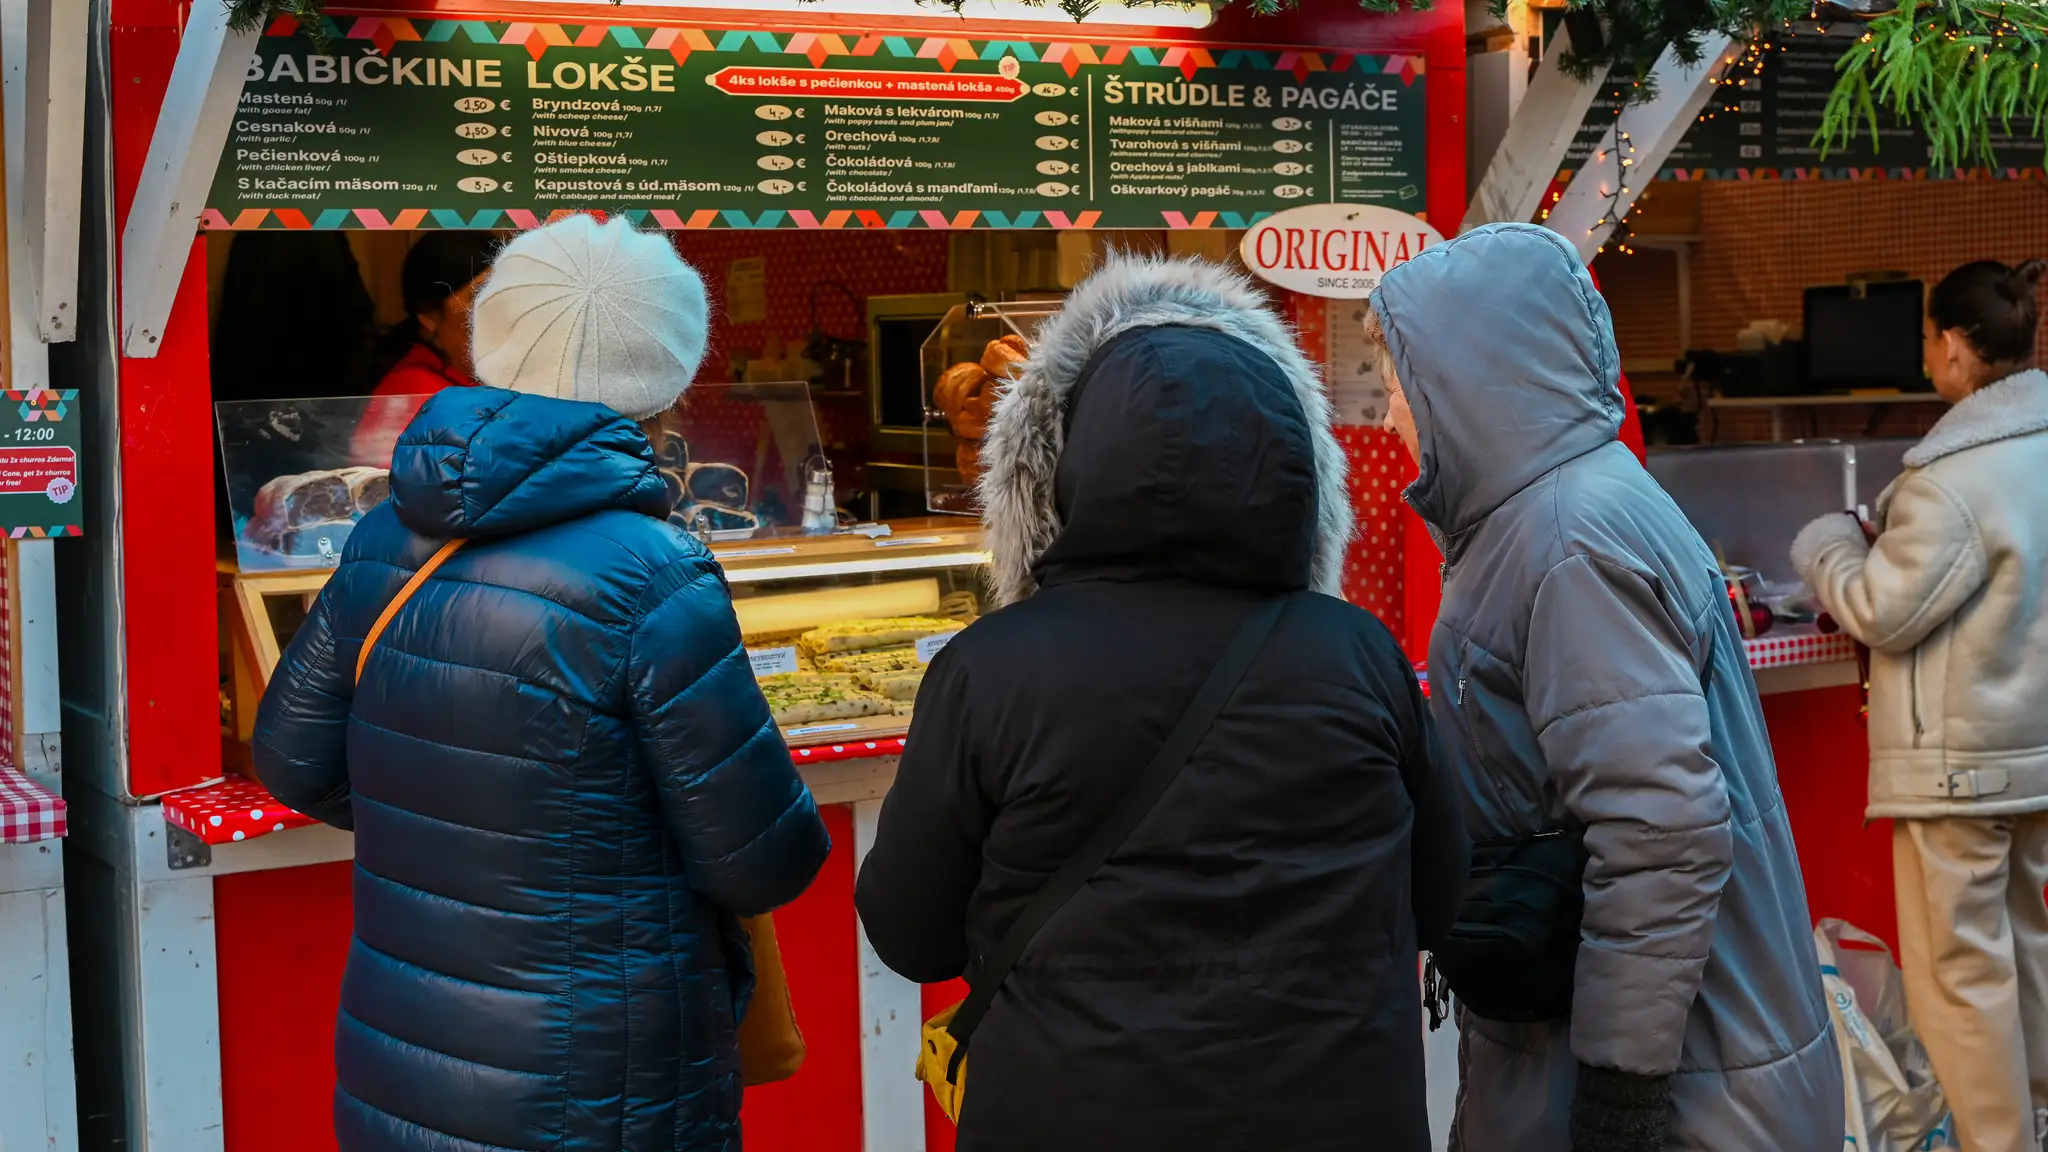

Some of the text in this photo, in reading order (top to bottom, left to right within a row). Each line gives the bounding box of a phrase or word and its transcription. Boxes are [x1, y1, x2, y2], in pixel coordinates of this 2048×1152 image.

[526, 56, 676, 92] LOKŠE
[1002, 63, 1016, 73] TIP
[728, 75, 755, 87] 4ks
[758, 75, 797, 88] lokše
[799, 79, 808, 88] s
[810, 77, 882, 90] pečienkou
[897, 81, 955, 92] mastená
[957, 81, 993, 93] lokša
[1103, 74, 1398, 111] ŠTRÚDLE & PAGÁČE
[238, 92, 314, 105] Mastená
[315, 98, 333, 107] 50g
[499, 99, 511, 111] €
[532, 98, 620, 112] Bryndzová
[622, 105, 642, 113] 100g
[794, 107, 806, 119] €
[262, 107, 293, 115] goose
[294, 107, 312, 115] fat/
[532, 111, 629, 121] /with scheep cheese/
[824, 104, 883, 117] Maková
[885, 107, 895, 117] s
[897, 105, 964, 118] lekvárom
[964, 111, 982, 120] 100g
[1069, 114, 1080, 125] €
[235, 120, 337, 134] Cesnaková
[338, 127, 357, 135] 50g
[500, 125, 512, 137] €
[824, 117, 846, 125] /with
[847, 118, 873, 127] poppy
[873, 118, 898, 126] seeds
[899, 118, 915, 126] and
[915, 119, 936, 127] plum
[1109, 115, 1160, 127] Maková
[1163, 119, 1172, 128] s
[1173, 116, 1224, 129] višňami
[1304, 120, 1313, 131] €
[533, 125, 590, 138] Nivová
[592, 131, 613, 139] 100g
[795, 133, 806, 145] €
[825, 129, 897, 142] Orechová
[898, 136, 917, 144] 100g
[1069, 138, 1080, 150] €
[532, 139, 557, 147] /with
[558, 139, 578, 147] blue
[824, 143, 847, 151] /with
[1109, 138, 1179, 150] Tvarohová
[1181, 142, 1189, 151] s
[1191, 140, 1242, 152] višňami
[1304, 142, 1314, 152] €
[236, 148, 341, 162] Pečienková
[344, 155, 365, 163] 100g
[501, 151, 512, 163] €
[534, 152, 627, 167] Oštiepková
[796, 157, 807, 169] €
[264, 163, 304, 171] chicken
[533, 166, 558, 174] /with
[595, 167, 632, 175] cheese/
[825, 153, 913, 168] Čokoládová
[914, 161, 933, 169] 100g
[1070, 163, 1080, 174] €
[1110, 161, 1174, 173] Orechová
[1176, 165, 1185, 173] s
[1186, 162, 1241, 174] jablkami
[1305, 164, 1314, 174] €
[1109, 173, 1129, 181] /with
[237, 178, 250, 190] S
[254, 177, 330, 190] kačacím
[335, 178, 399, 190] mäsom
[402, 183, 423, 192] 120g
[502, 181, 514, 193] €
[534, 178, 622, 194] Kapustová
[626, 182, 635, 192] s
[638, 179, 721, 192] úd.mäsom
[723, 185, 742, 193] 120g
[796, 181, 808, 192] €
[826, 178, 913, 193] Čokoládová
[915, 184, 925, 193] s
[927, 182, 998, 194] mandľami
[998, 187, 1015, 195] 120g
[1070, 184, 1081, 196] €
[1110, 184, 1188, 198] Oškvarkový
[1191, 184, 1231, 198] pagáč
[1305, 186, 1315, 197] €
[237, 192, 322, 200] /with duck meat/
[534, 193, 558, 201] /with
[560, 193, 599, 202] cabbage
[826, 194, 848, 202] /with
[848, 194, 887, 202] chocolate
[888, 194, 905, 202] and
[1317, 277, 1376, 290] SINCE 2005
[14, 427, 55, 441] 12:00
[10, 456, 19, 464] 2x
[19, 456, 46, 464] churros
[23, 470, 35, 478] get
[44, 469, 72, 477] churros
[5, 479, 22, 487] free!
[51, 484, 69, 497] TIP
